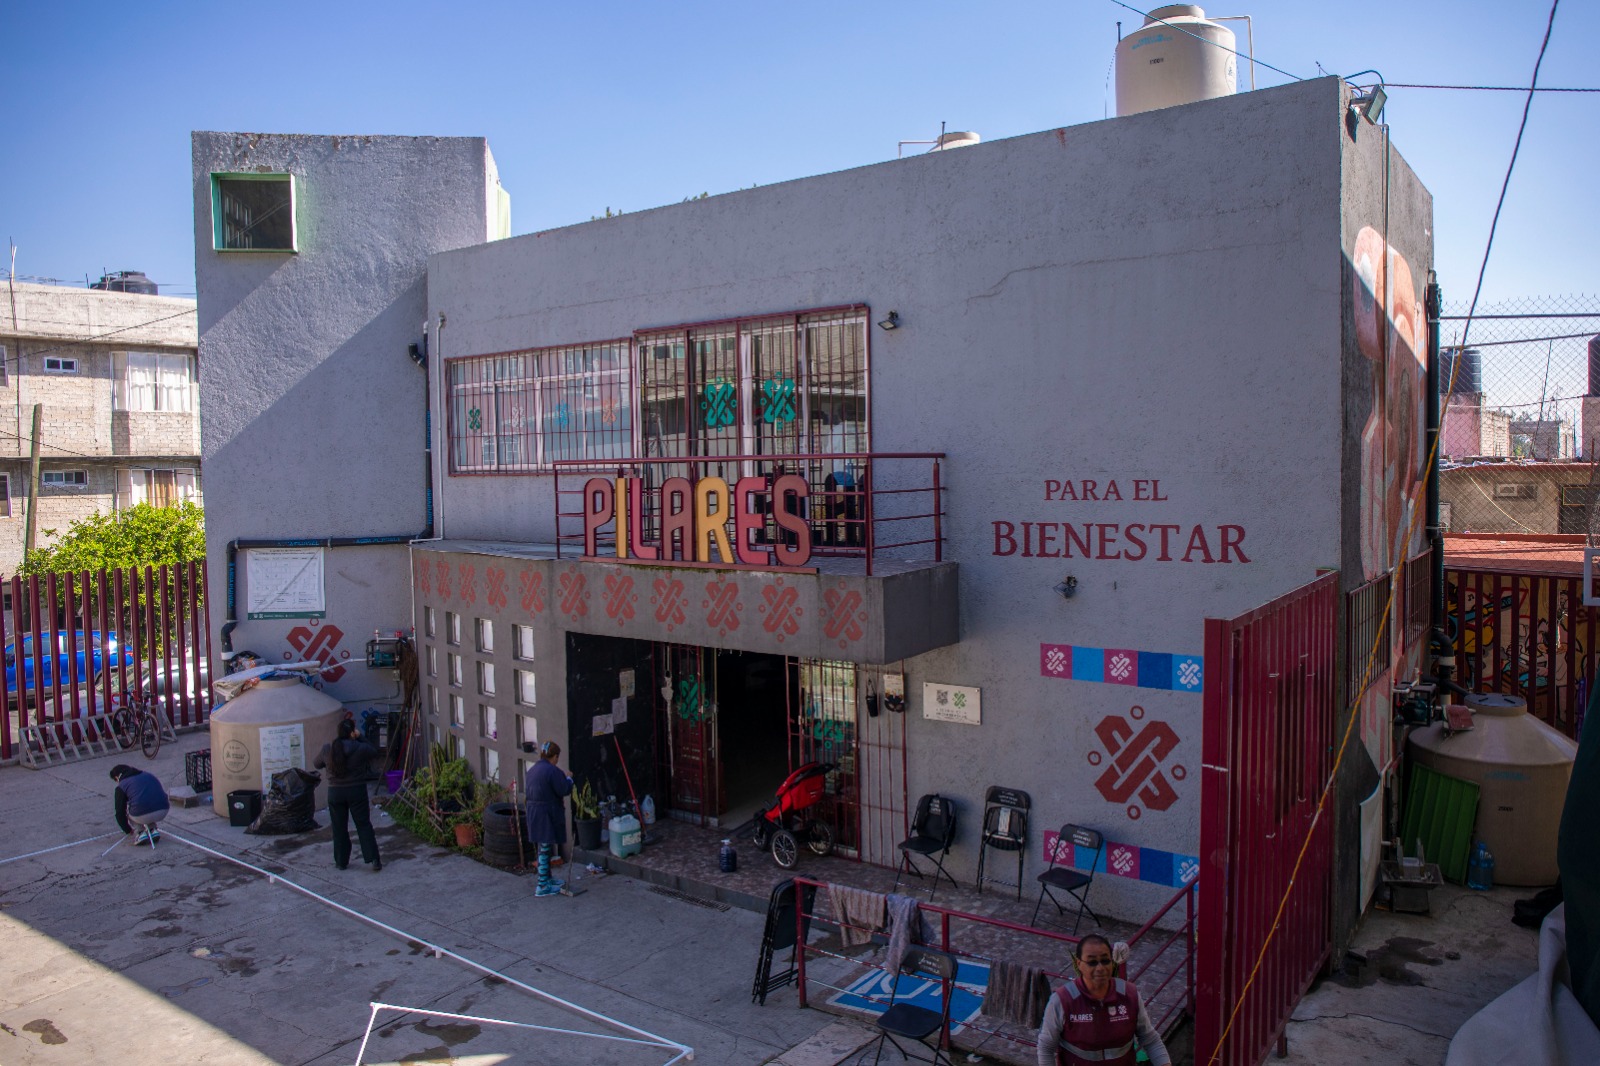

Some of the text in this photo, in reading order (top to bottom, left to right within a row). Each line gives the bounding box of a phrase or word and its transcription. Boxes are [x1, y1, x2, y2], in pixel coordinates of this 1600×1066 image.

[1044, 479, 1168, 501] PARA EL
[583, 474, 811, 566] PILARES
[991, 520, 1251, 564] BIENESTAR
[1069, 1013, 1093, 1021] PILARES
